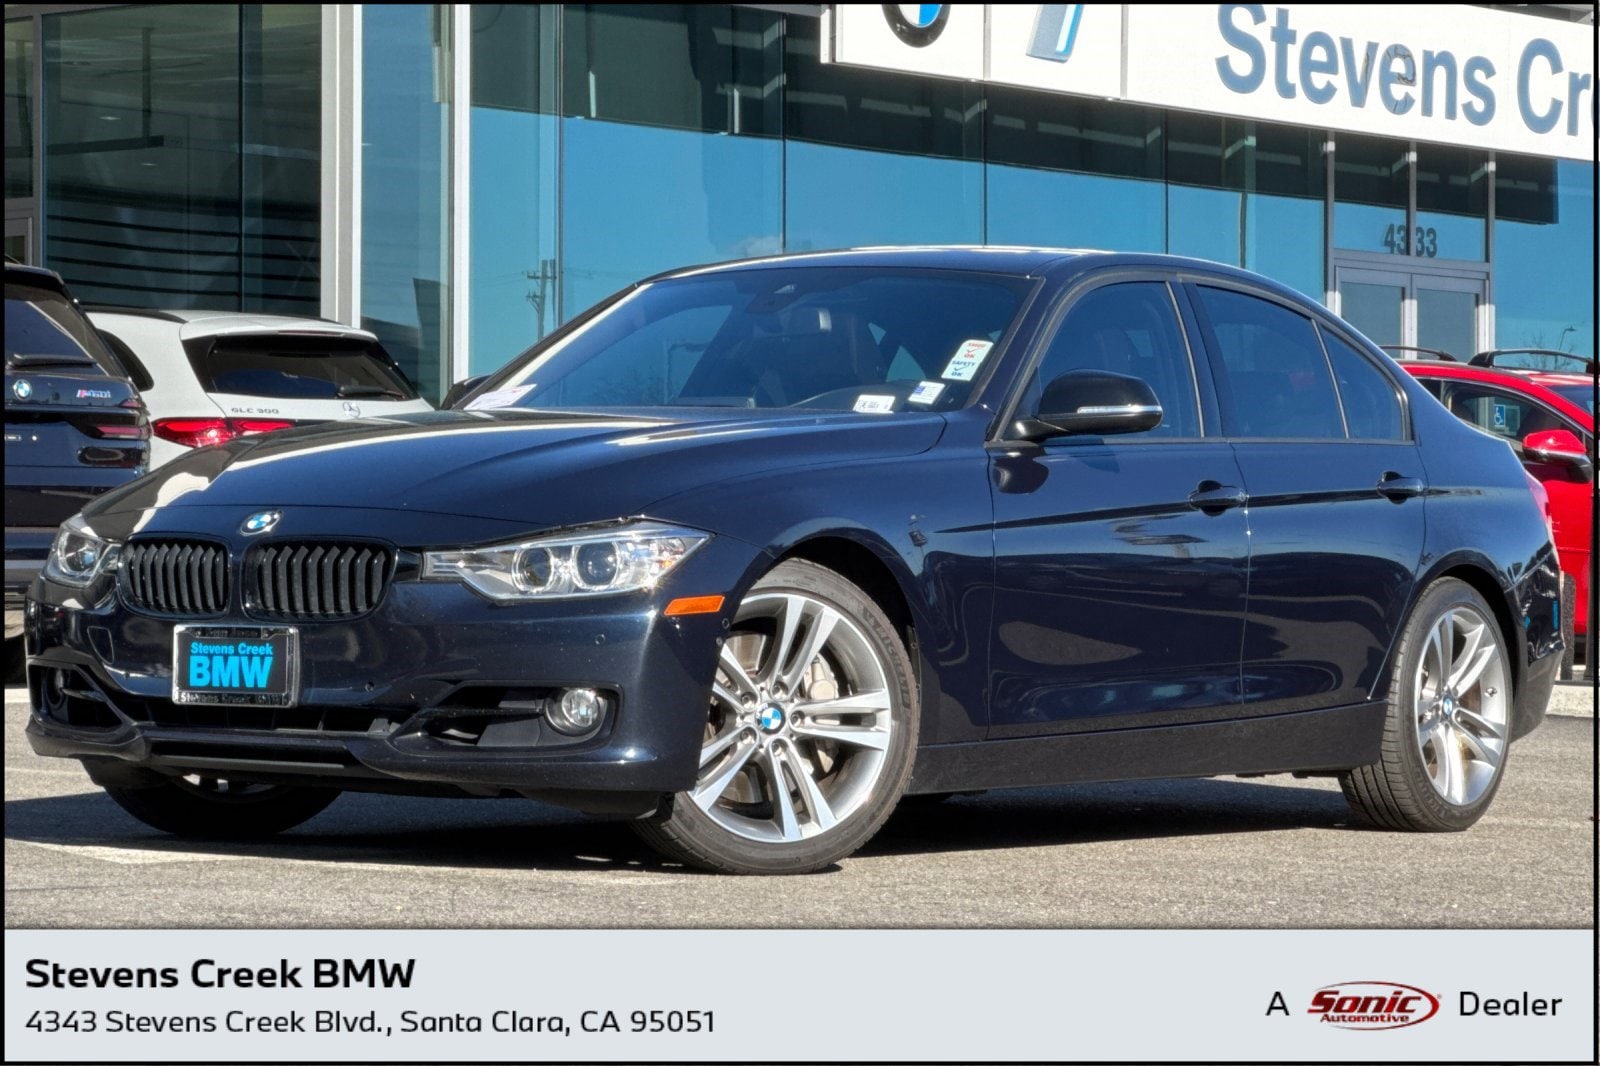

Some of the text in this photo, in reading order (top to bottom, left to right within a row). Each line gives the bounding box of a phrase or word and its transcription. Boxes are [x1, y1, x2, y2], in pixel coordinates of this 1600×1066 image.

[1215, 4, 1594, 136] Stevens Cr
[1383, 223, 1438, 258] 4333
[190, 641, 273, 656] Stevens Creek
[189, 655, 274, 689] BMW
